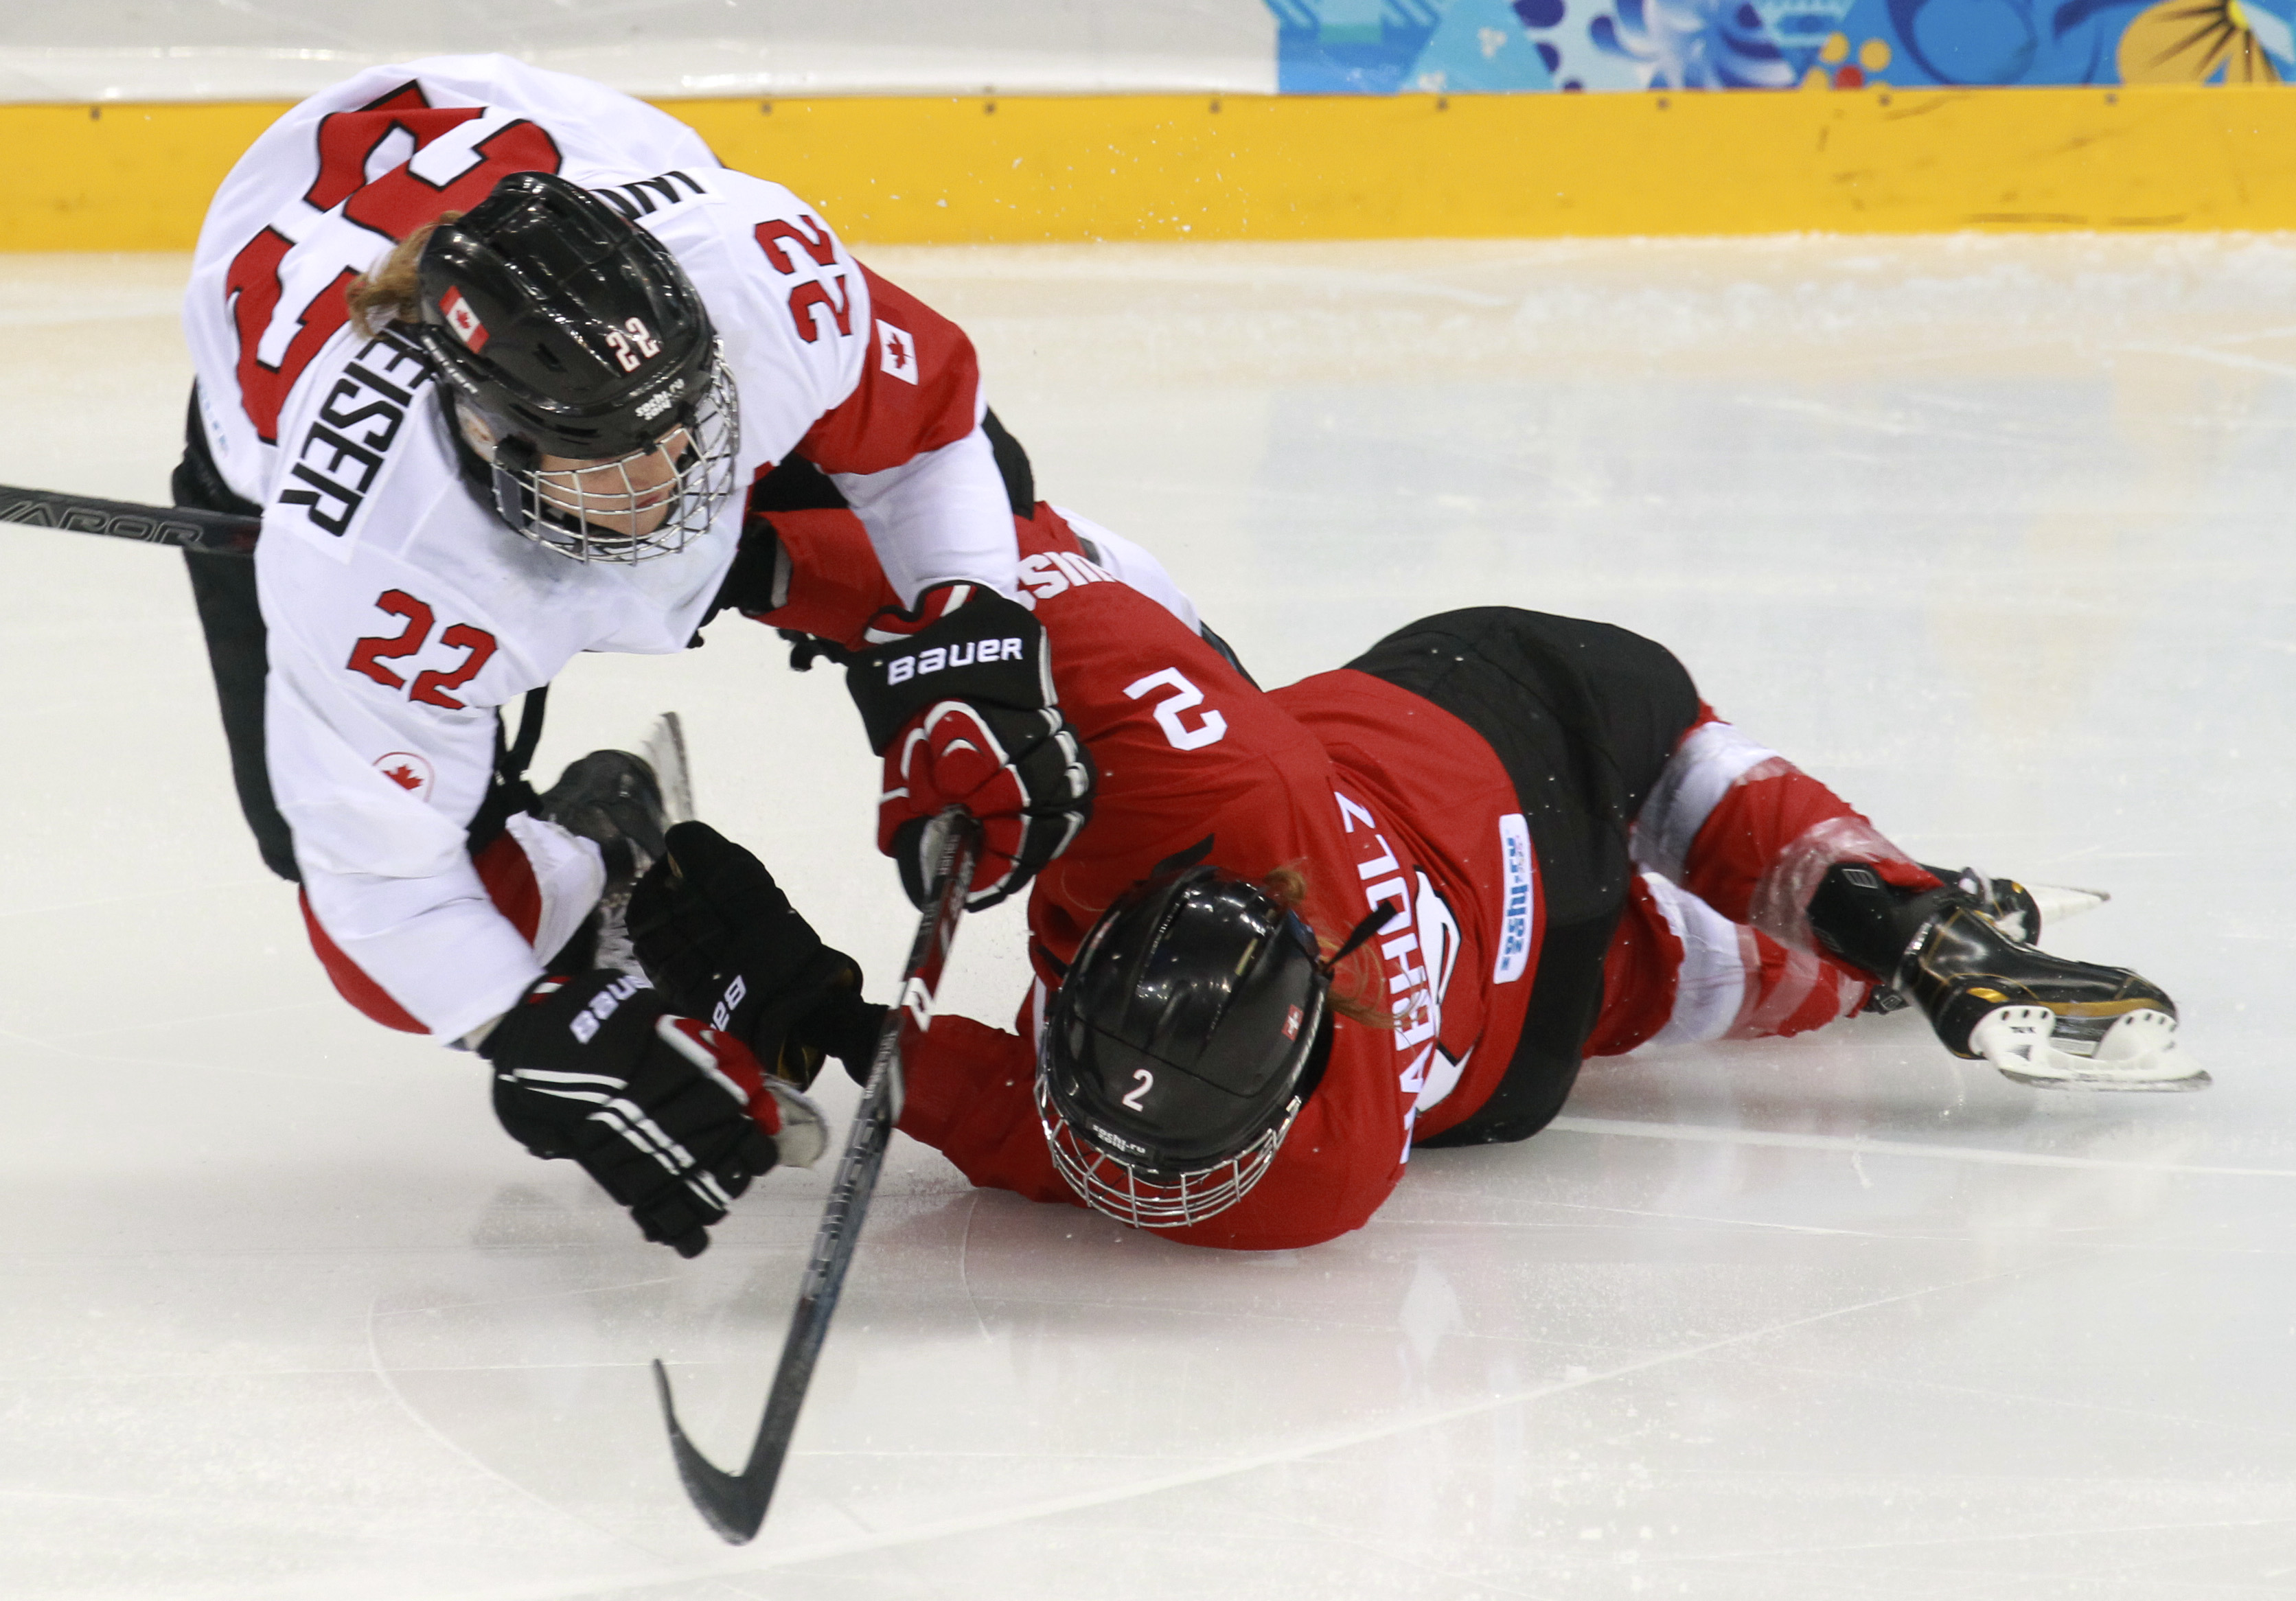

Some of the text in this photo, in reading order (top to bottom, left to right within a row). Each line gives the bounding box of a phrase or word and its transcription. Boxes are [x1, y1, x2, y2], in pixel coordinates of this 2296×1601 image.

[226, 79, 563, 447] 22
[753, 214, 851, 344] 22
[606, 316, 661, 373] 22
[345, 588, 499, 710] 22
[1123, 666, 1228, 752] 2
[1122, 1068, 1153, 1112] 2
